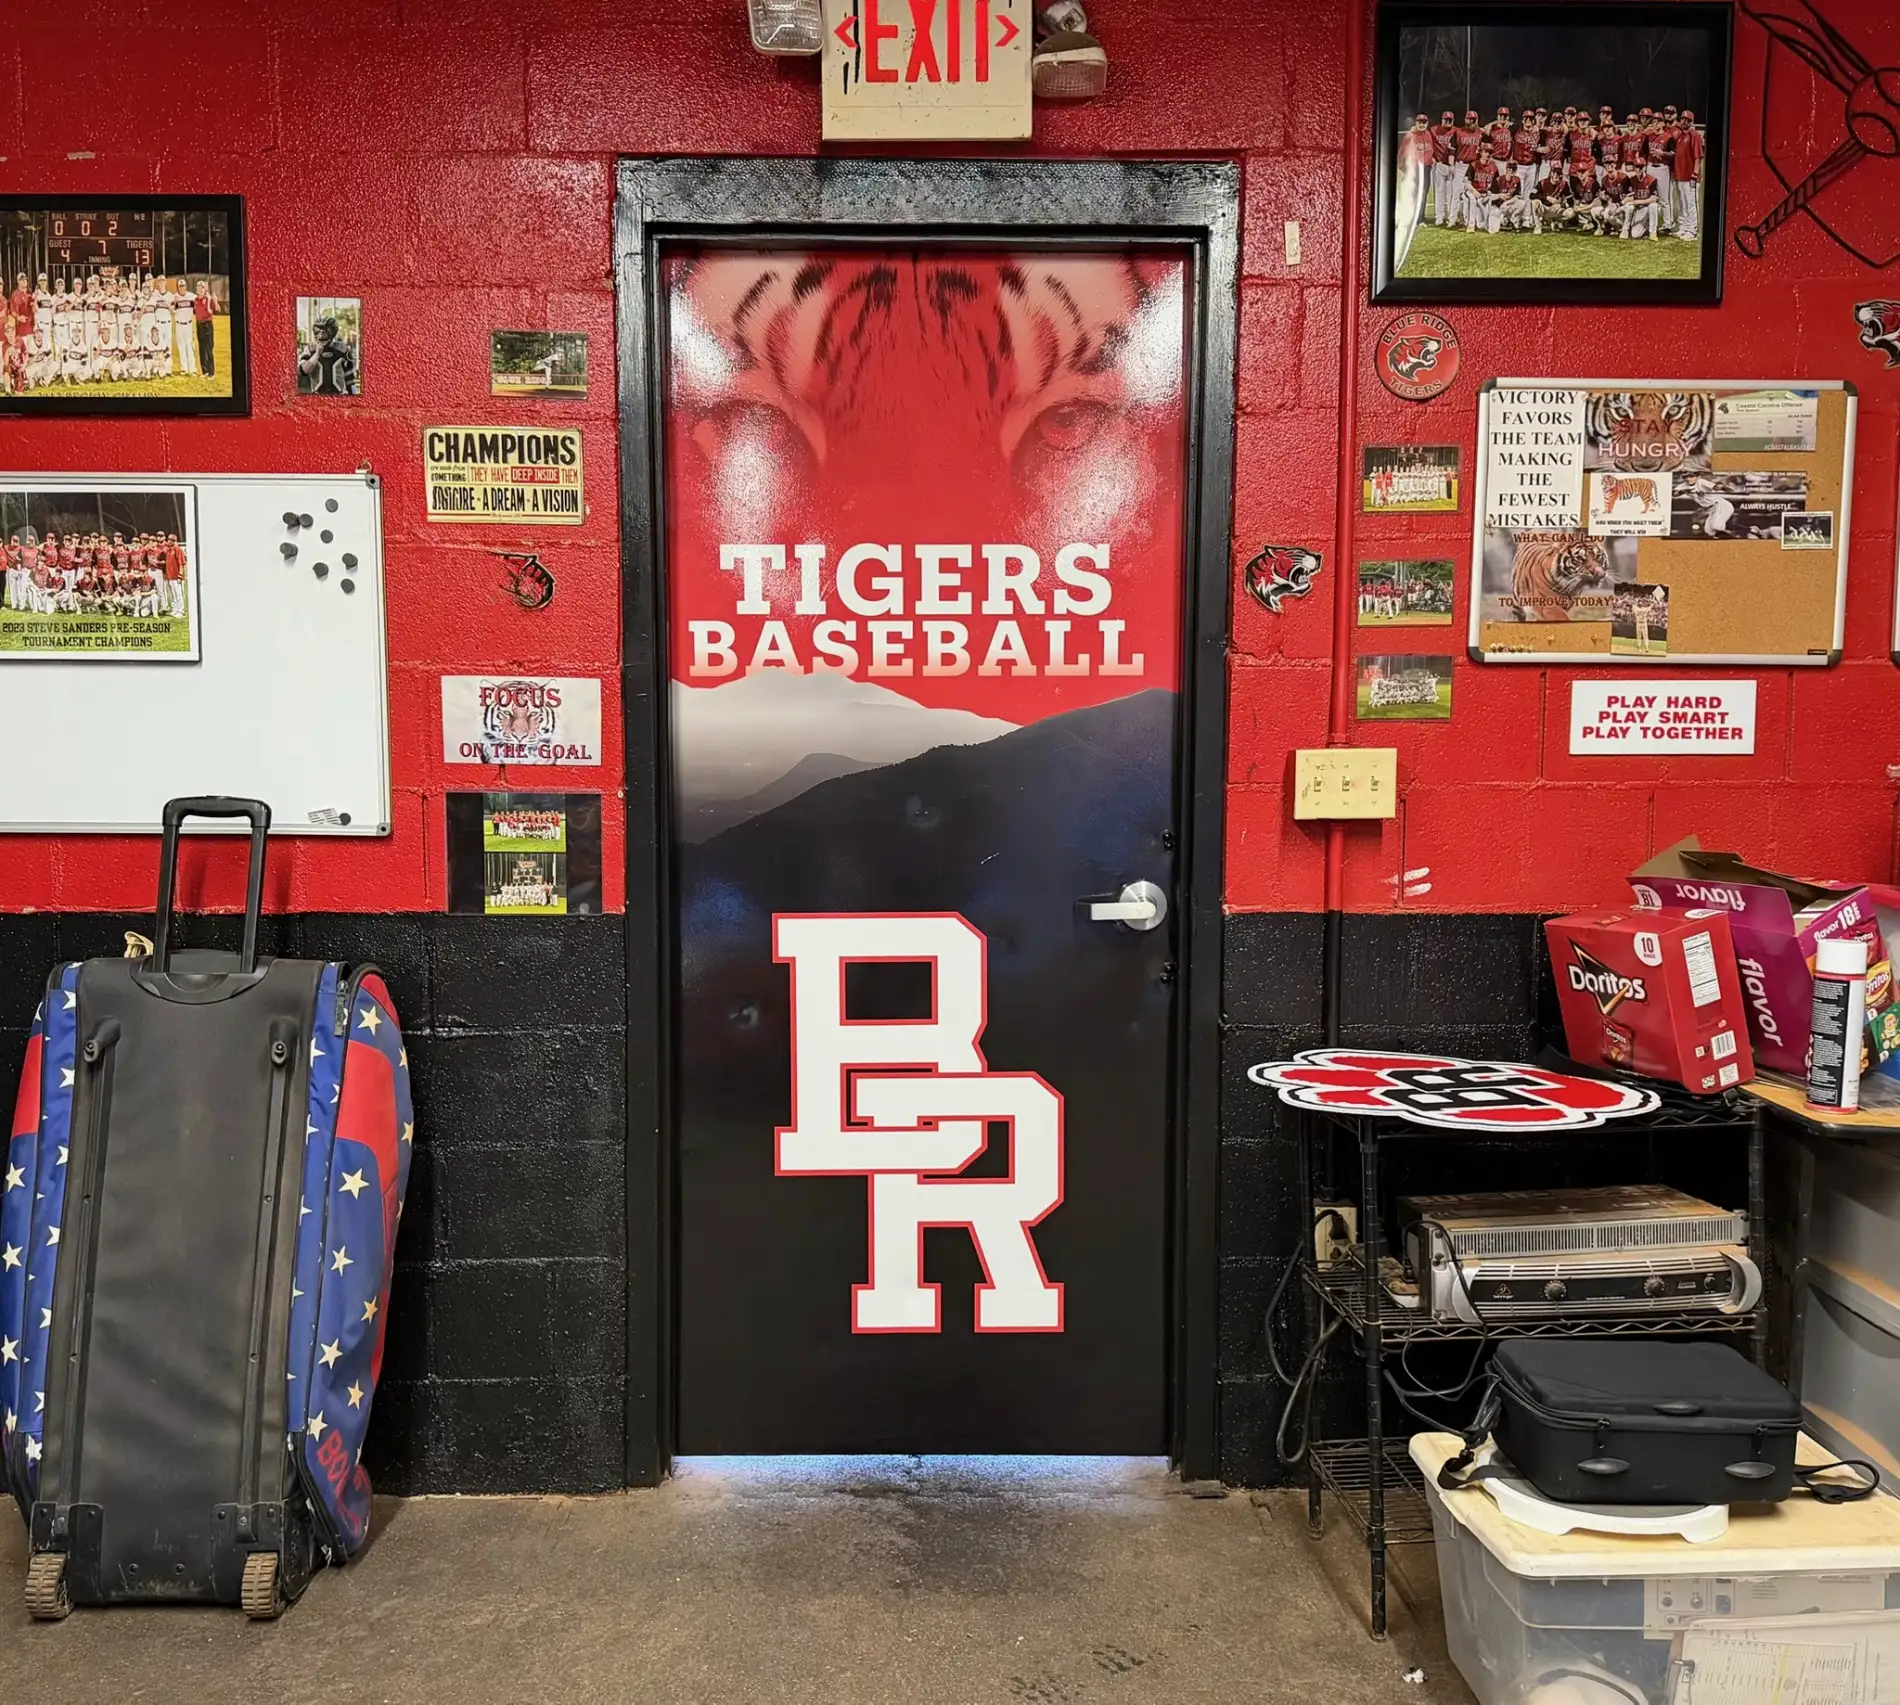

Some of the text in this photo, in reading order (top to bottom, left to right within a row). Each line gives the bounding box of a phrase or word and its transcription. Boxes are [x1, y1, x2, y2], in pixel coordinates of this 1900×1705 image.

[865, 0, 988, 82] EXIT
[55, 221, 117, 236] 0 0 2
[49, 240, 71, 248] GUEST
[98, 240, 106, 254] 7
[126, 241, 153, 249] TIGERS
[61, 249, 70, 262] 4
[135, 249, 150, 265] 13
[1383, 315, 1457, 349] BLUE RIDGE
[1390, 376, 1443, 396] TIGERS
[1498, 391, 1578, 404] VICTORY
[1502, 412, 1573, 425] FAVORS
[1620, 420, 1674, 433] STAY
[1491, 432, 1582, 445] THE TEAM
[428, 432, 576, 465] CHAMPIONS
[1599, 443, 1693, 457] HUNGRY
[1499, 453, 1573, 466] MAKING
[470, 467, 488, 482] THEY
[491, 467, 510, 482] HAVE
[512, 468, 533, 481] DEEP
[534, 469, 558, 482] INSIDE
[1517, 473, 1552, 486] THE
[491, 487, 525, 511] DREAM
[541, 489, 578, 512] VISION
[1499, 493, 1570, 506] FEWEST
[1489, 514, 1578, 526] MISTAKES
[1514, 533, 1546, 542] WHAT
[1552, 533, 1576, 542] CAN
[719, 542, 1112, 617] TIGERS
[1498, 597, 1513, 606] TO
[1519, 597, 1569, 606] IMPROVE
[2, 622, 171, 633] 2023 STEVE SANDERS PRE-SEASON
[22, 636, 153, 647] TOURNAMENT CHAMPIONS
[689, 620, 1144, 677] BASEBALL
[479, 687, 562, 708] FOCUS
[1607, 695, 1722, 709] PLAY HARD
[1598, 711, 1729, 724] PLAY SMART
[1582, 726, 1743, 740] PLAY TOGETHER
[459, 743, 592, 760] ON THE GOAL
[1675, 884, 1746, 911] flavor
[1837, 905, 1856, 930] 18
[1641, 937, 1655, 954] 10
[1568, 965, 1646, 1000] Doritos
[1739, 957, 1784, 1047] flavor
